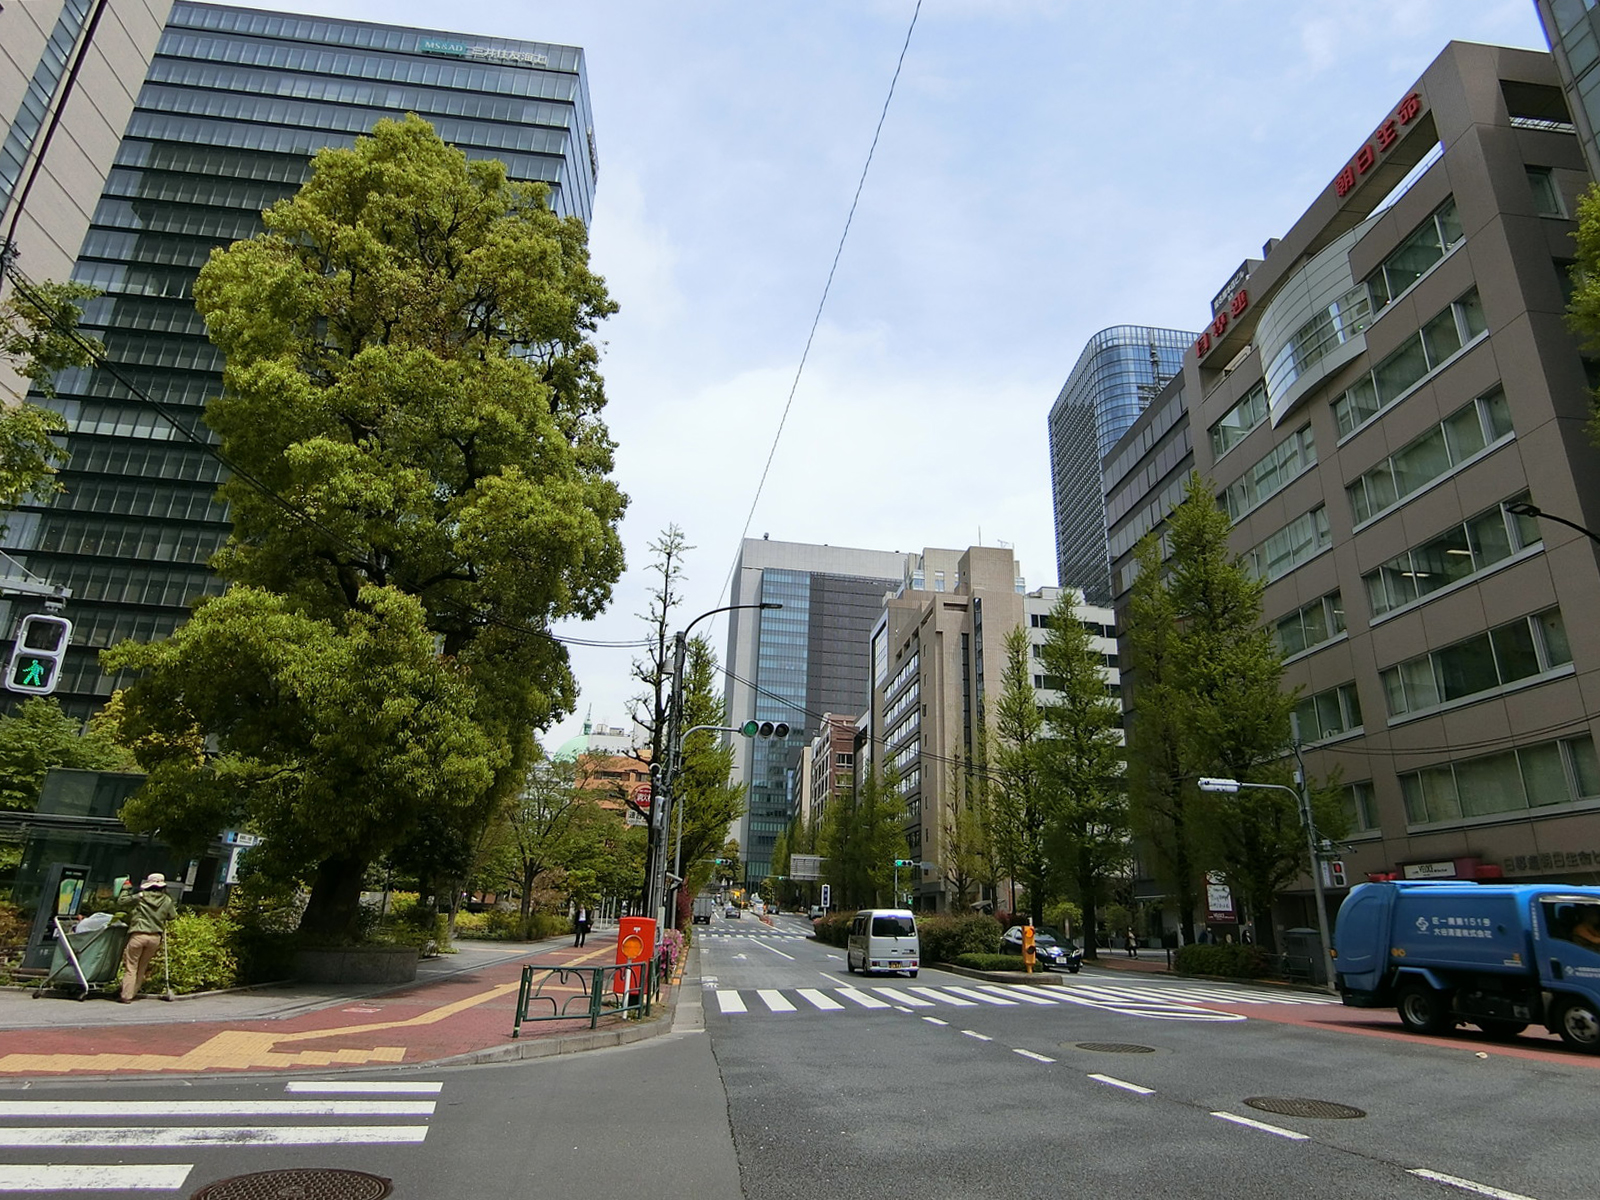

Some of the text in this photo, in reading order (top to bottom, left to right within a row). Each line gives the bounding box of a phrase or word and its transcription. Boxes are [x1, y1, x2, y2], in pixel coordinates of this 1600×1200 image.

[425, 41, 463, 52] MS&AD
[1335, 92, 1422, 198] 朝日生命
